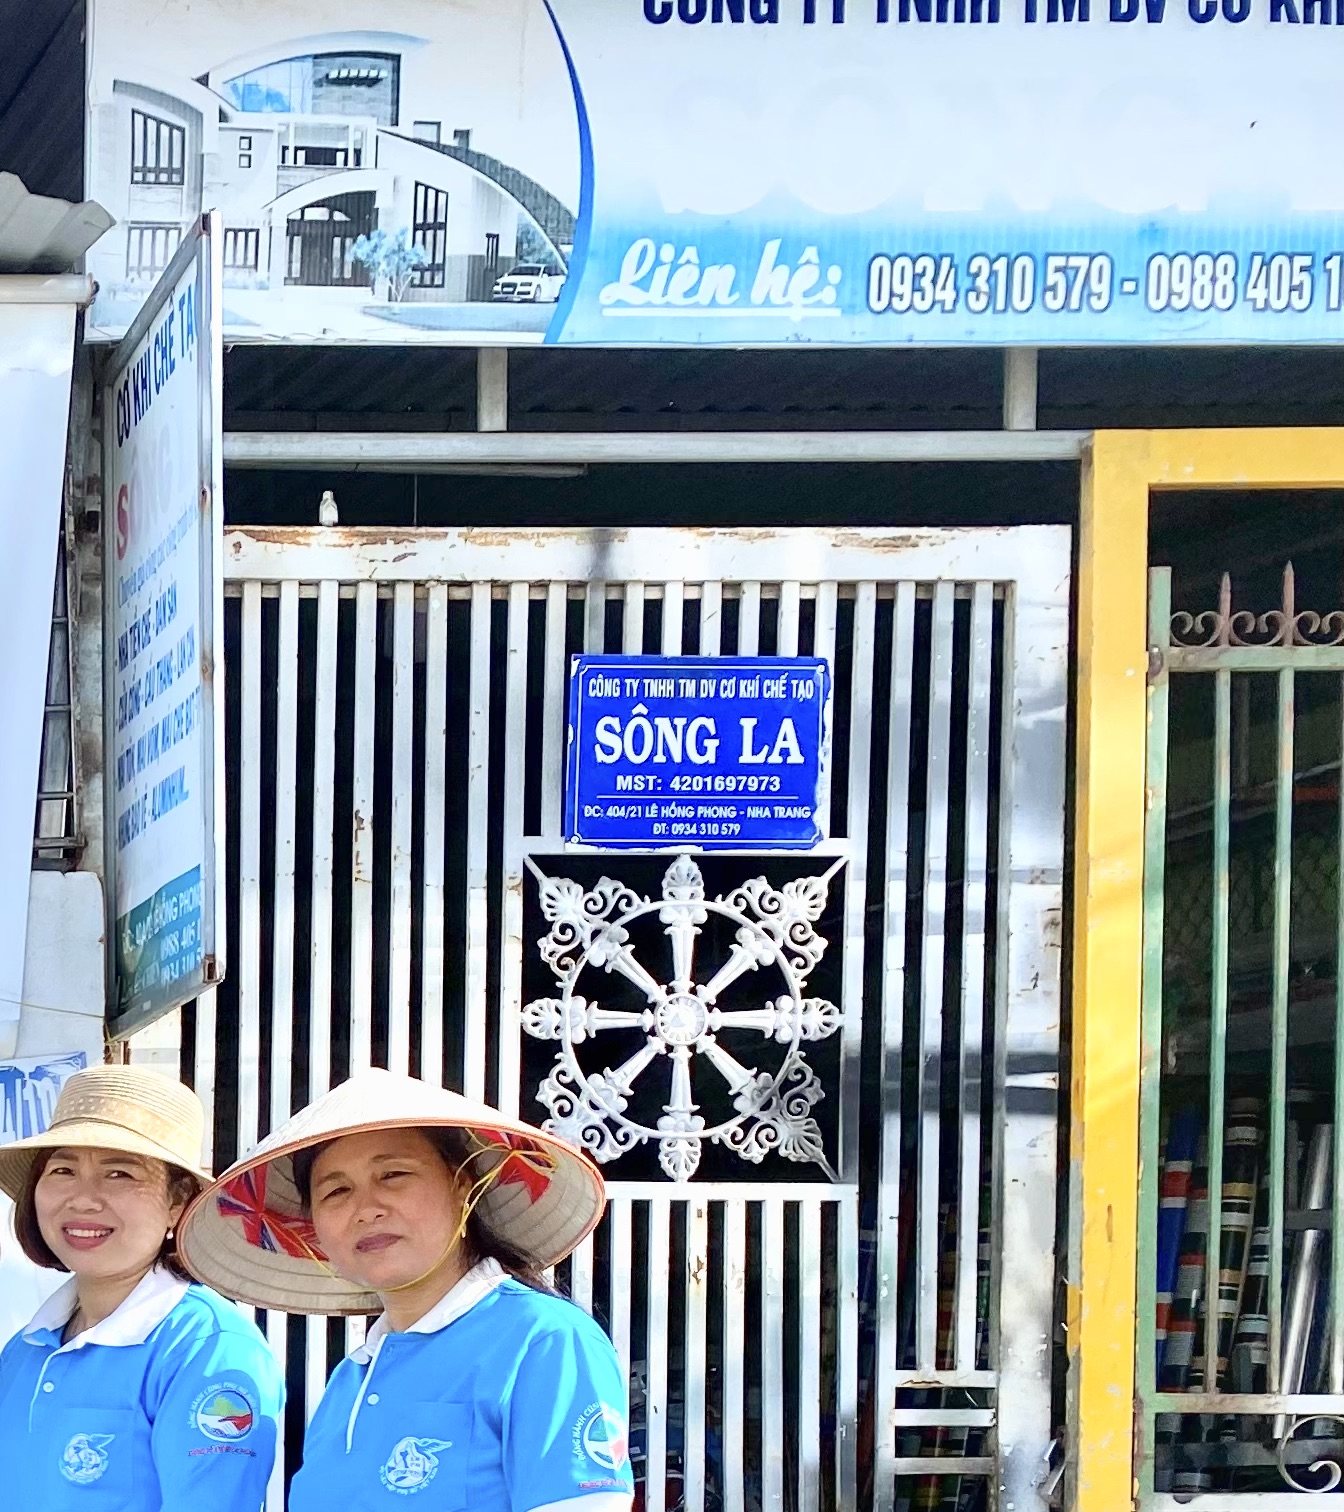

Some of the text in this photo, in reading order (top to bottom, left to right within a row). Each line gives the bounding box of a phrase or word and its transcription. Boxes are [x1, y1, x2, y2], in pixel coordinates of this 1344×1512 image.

[599, 238, 740, 306] Liên
[750, 237, 842, 321] hệ:
[867, 252, 957, 314] 0934
[965, 252, 1036, 313] 310
[1043, 252, 1113, 313] 579
[1147, 251, 1238, 312] 0988
[1245, 251, 1314, 312] 405
[1323, 252, 1344, 312] 1
[588, 673, 621, 698] CÔNG
[624, 678, 641, 698] TY
[643, 678, 675, 698] TNHH
[679, 678, 697, 698] TM
[699, 679, 717, 698] DV
[738, 674, 761, 699] KHÍ
[763, 672, 789, 699] CHẾ
[791, 679, 815, 703] TẠO
[594, 702, 805, 765] SÔNG LA
[616, 774, 781, 792] MST: 4201697973
[606, 805, 643, 820] 404/21
[645, 802, 659, 818] LÊ
[697, 805, 737, 818] PHONG
[747, 805, 772, 819] NHA
[773, 805, 812, 819] TRANG
[671, 822, 698, 836] 0934
[699, 822, 720, 836] 310
[720, 822, 742, 836] 579
